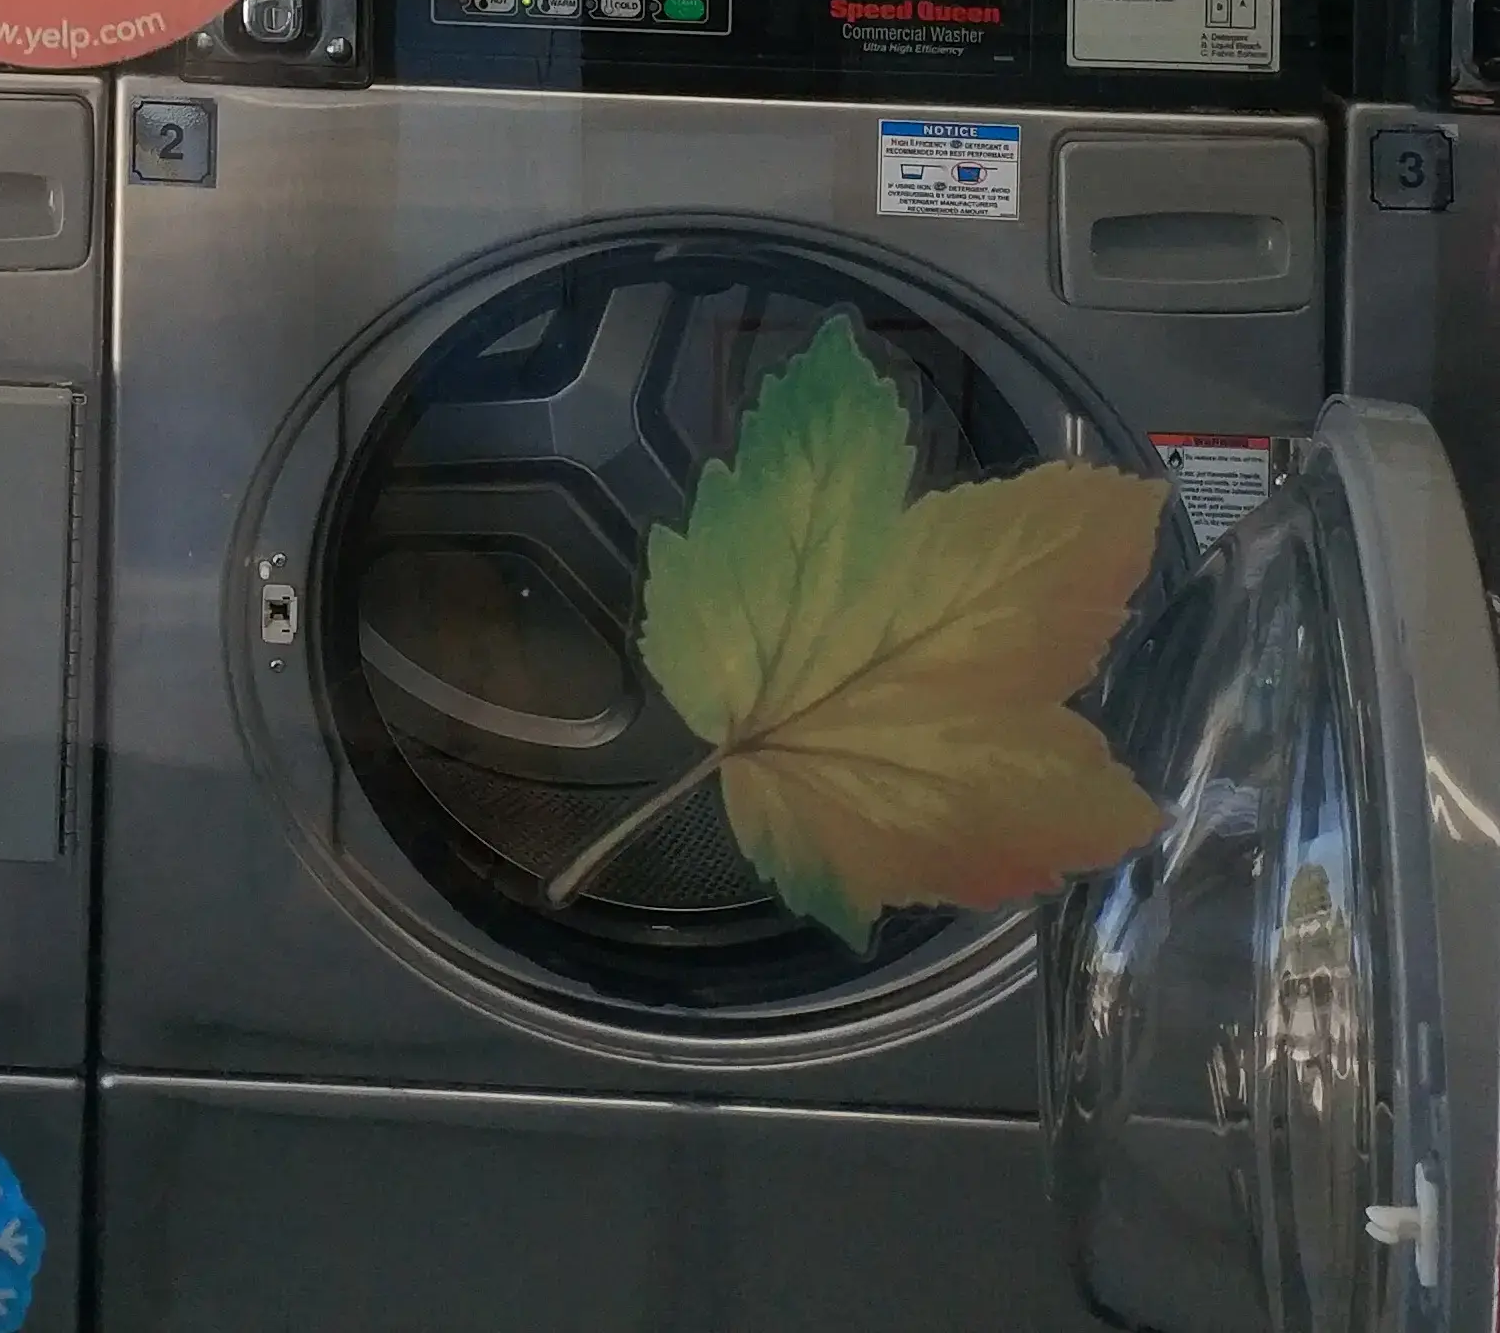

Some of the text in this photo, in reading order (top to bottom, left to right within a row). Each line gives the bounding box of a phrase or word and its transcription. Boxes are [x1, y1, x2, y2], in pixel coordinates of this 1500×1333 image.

[548, 0, 575, 8] WARM
[613, 1, 637, 10] COLD
[917, 0, 1001, 23] Queen
[1239, 0, 1248, 8] A
[842, 23, 985, 44] Commercial Washer
[863, 42, 964, 57] Ultra High Efficiency
[923, 125, 979, 137] NOTICE
[159, 123, 184, 160] 2
[1398, 151, 1425, 188] 3
